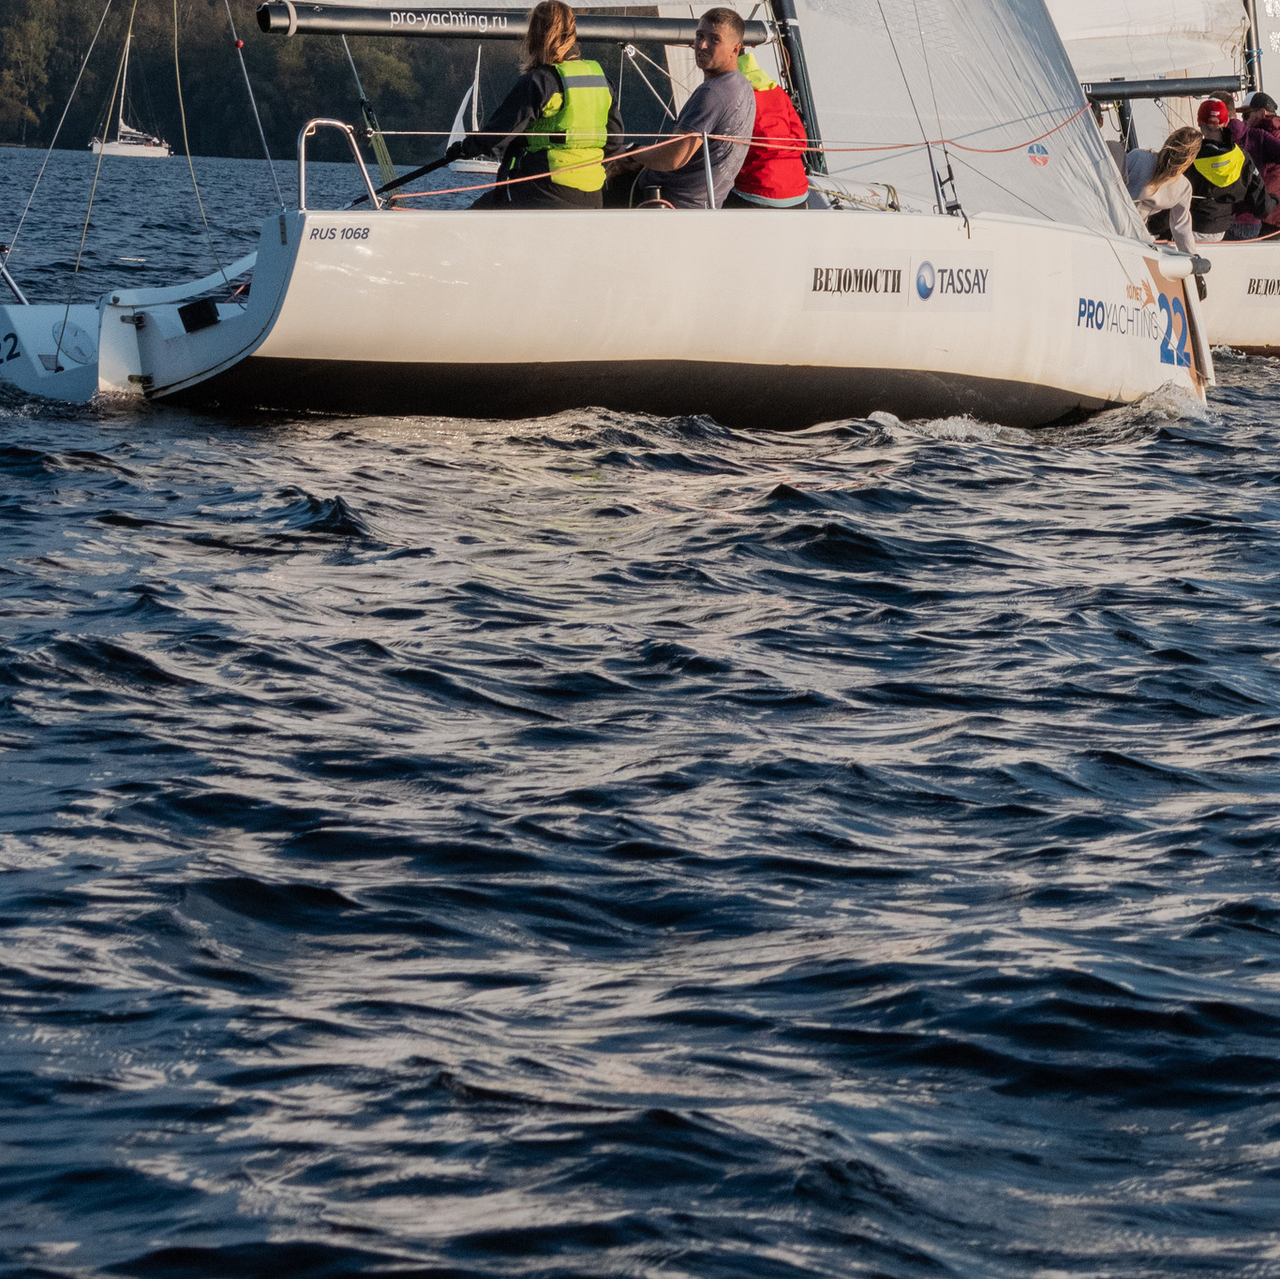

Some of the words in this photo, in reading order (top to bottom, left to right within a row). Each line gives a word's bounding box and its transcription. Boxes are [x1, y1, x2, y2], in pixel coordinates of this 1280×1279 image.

[390, 10, 508, 33] pro-yachting.ru
[309, 227, 338, 240] RUS
[340, 227, 370, 240] 1068
[811, 267, 902, 297] ВЕДОМОСТИ
[937, 268, 989, 294] TASSAY
[1077, 297, 1159, 341] PROYACHTING
[1157, 292, 1192, 368] 22
